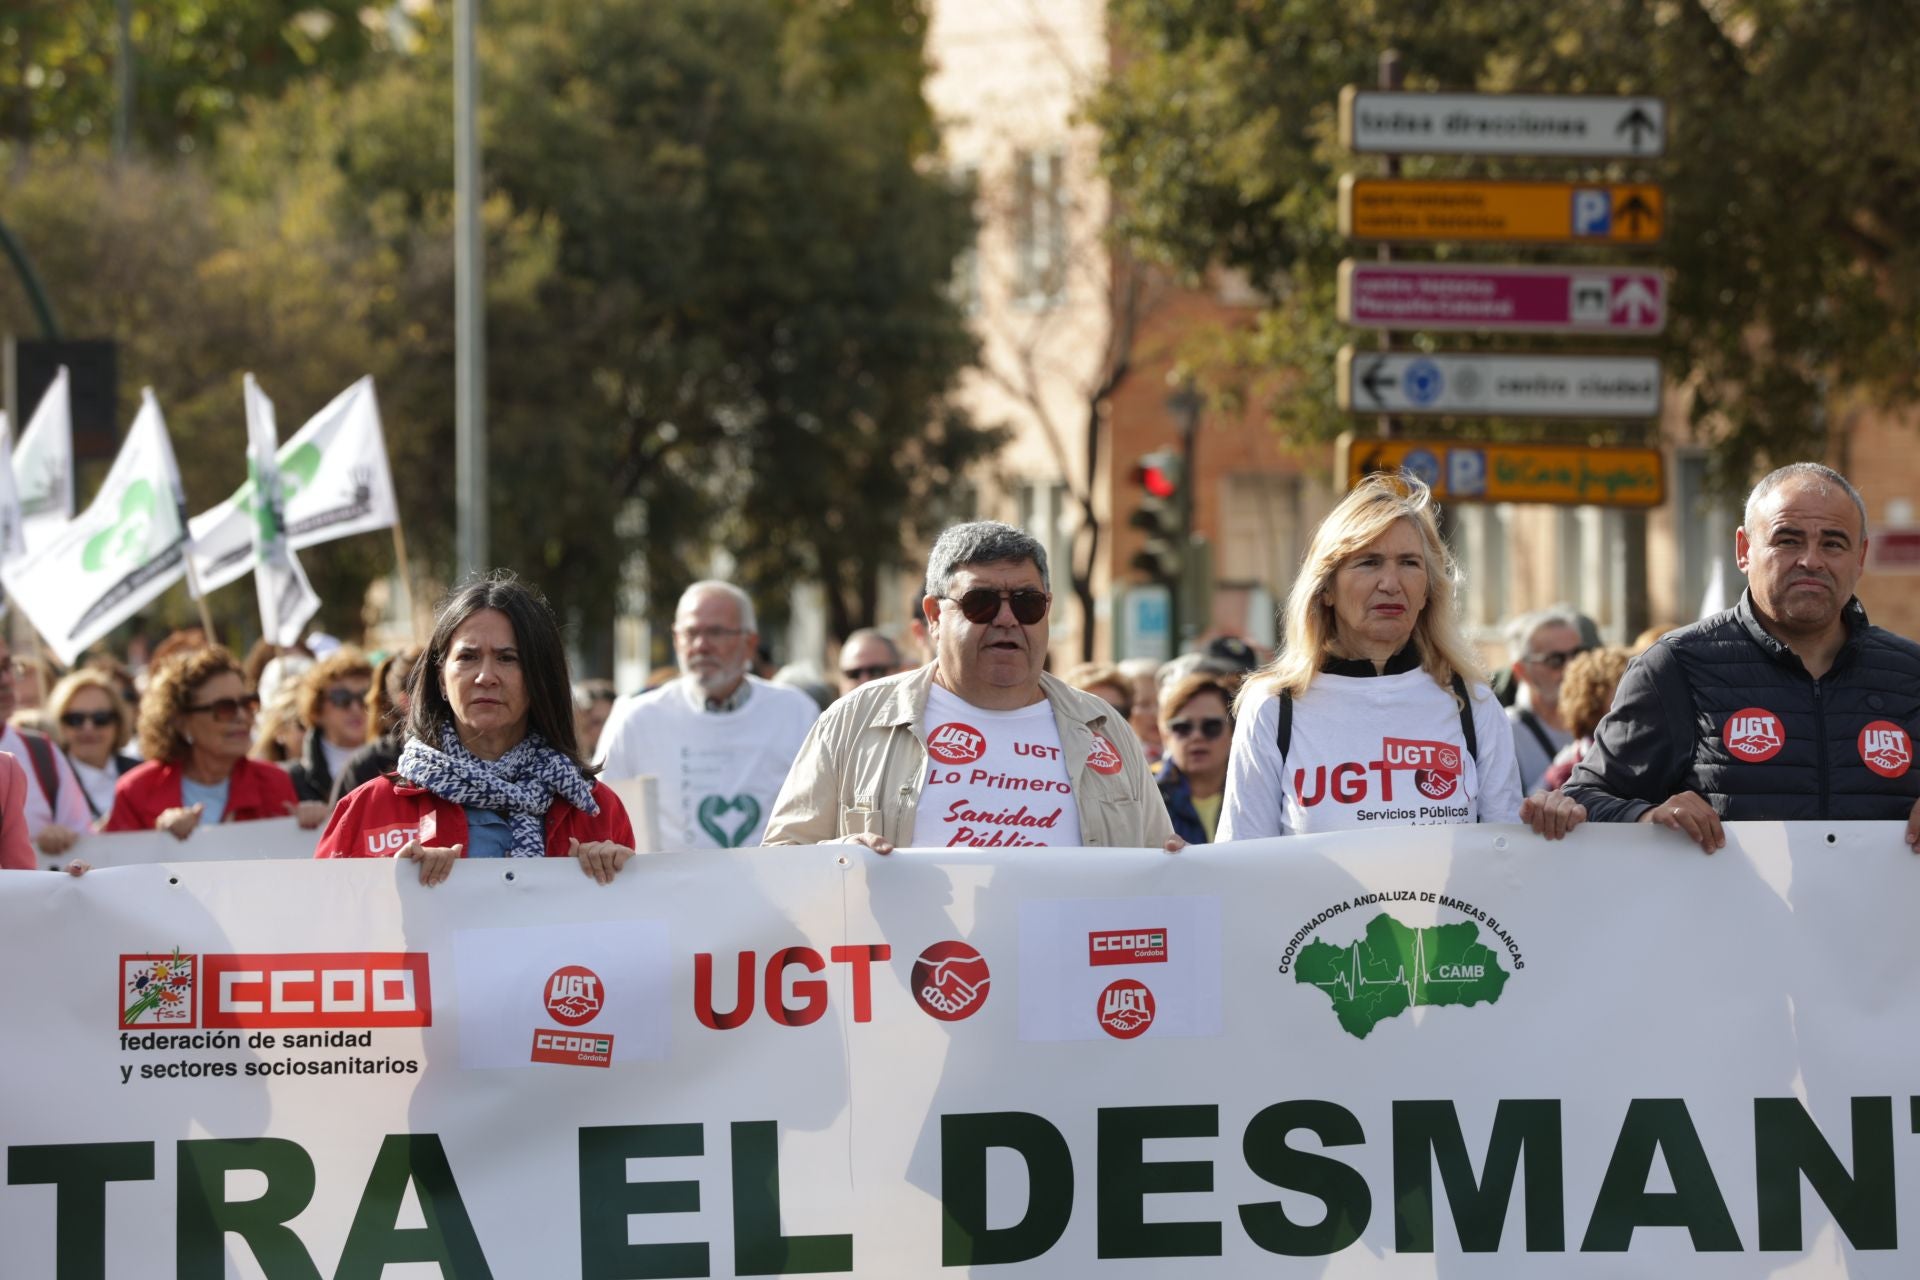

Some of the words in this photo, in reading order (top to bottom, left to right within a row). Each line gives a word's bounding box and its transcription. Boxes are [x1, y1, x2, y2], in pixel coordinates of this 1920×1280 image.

[1361, 110, 1432, 132] todas
[1445, 109, 1588, 135] direcciones
[932, 726, 982, 751] UGT
[1732, 717, 1775, 738] UGT
[1013, 743, 1059, 760] UGT
[1865, 730, 1904, 752] UGT
[1387, 744, 1435, 764] UGT
[928, 770, 961, 785] Lo
[969, 770, 1071, 794] Primero
[1294, 762, 1392, 807] UGT
[943, 799, 1062, 828] Sanidad
[1357, 809, 1416, 820] Servicios
[1420, 806, 1469, 819] Públicos
[368, 828, 419, 853] UGT
[1093, 934, 1150, 951] CCOO
[1279, 901, 1351, 974] COORDINADORA
[1353, 891, 1416, 908] ANDALUZA
[1420, 891, 1437, 903] DE
[1438, 895, 1486, 921] MAREAS
[1486, 918, 1524, 970] BLANCAS
[1439, 965, 1485, 979] CAMB
[219, 969, 415, 1013] CCOO
[551, 975, 596, 1000] UGT
[694, 944, 890, 1030] UGT
[1104, 988, 1148, 1014] UGT
[120, 1030, 240, 1050] federación
[248, 1031, 276, 1049] de
[282, 1030, 372, 1048] sanidad
[537, 1035, 595, 1052] CCOO
[120, 1064, 133, 1085] y
[141, 1061, 238, 1079] sectores
[244, 1057, 419, 1076] sociosanitarios
[8, 1133, 494, 1280] TRA
[578, 1120, 853, 1280] EL
[940, 1095, 1920, 1267] DESMAN
